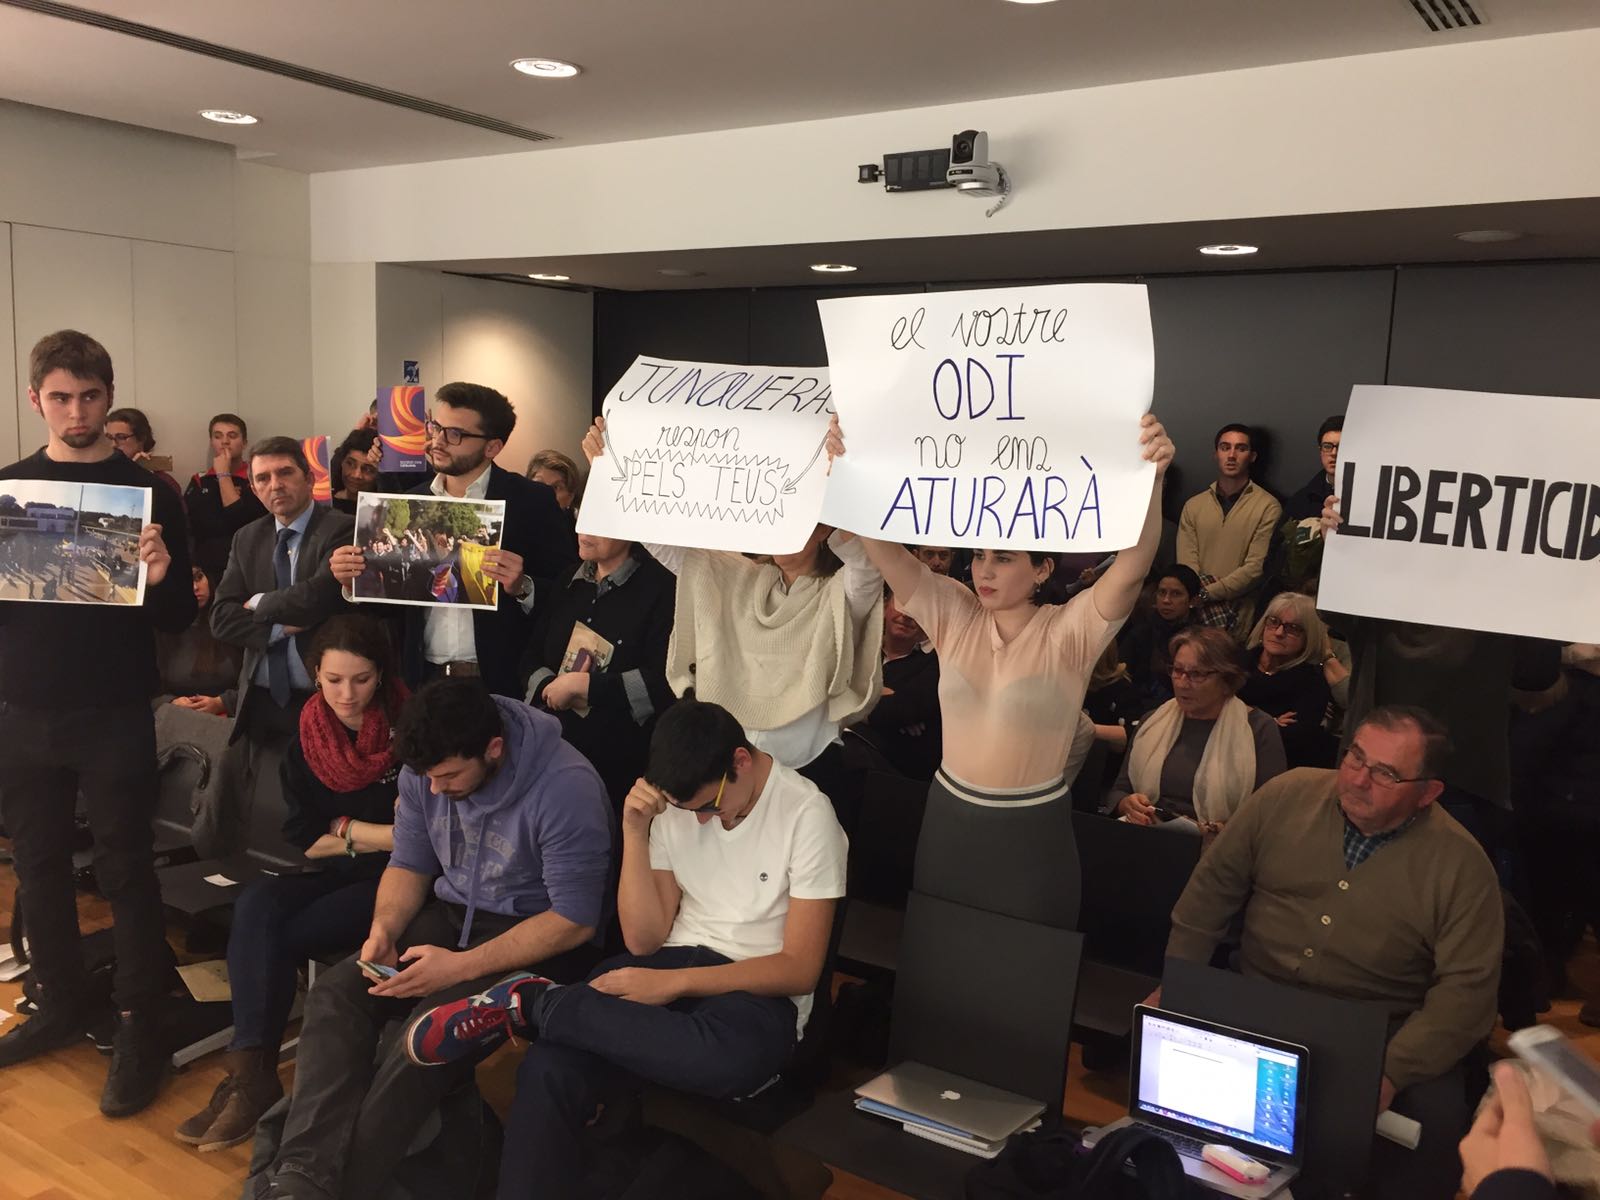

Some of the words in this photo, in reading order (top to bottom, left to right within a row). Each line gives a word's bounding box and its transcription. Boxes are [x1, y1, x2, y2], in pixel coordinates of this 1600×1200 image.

[890, 307, 926, 350] el
[951, 303, 1068, 348] vostre
[933, 354, 1026, 421] ODI
[656, 425, 740, 465] respon
[914, 434, 967, 470] no
[991, 434, 1053, 472] ens
[629, 460, 686, 499] PELS
[709, 464, 778, 506] TEUS
[880, 455, 1102, 540] ATURARÀ
